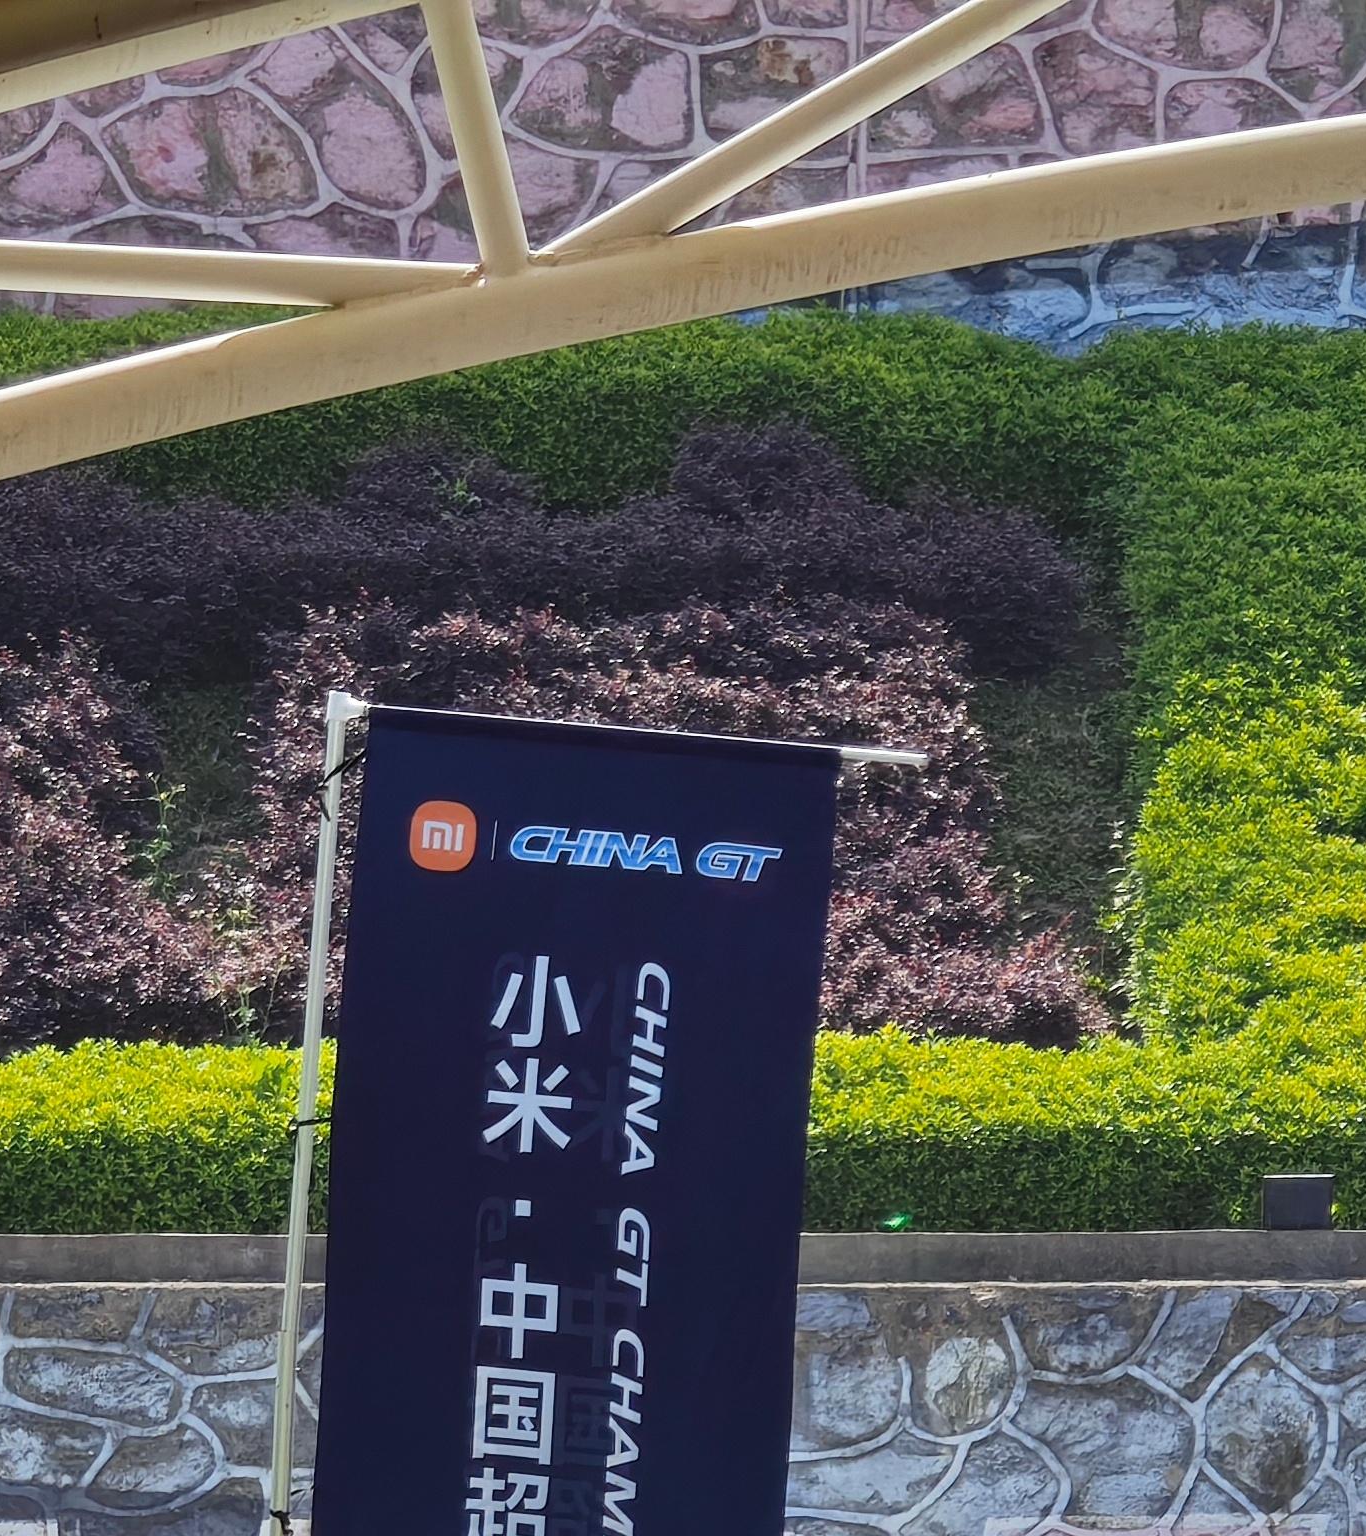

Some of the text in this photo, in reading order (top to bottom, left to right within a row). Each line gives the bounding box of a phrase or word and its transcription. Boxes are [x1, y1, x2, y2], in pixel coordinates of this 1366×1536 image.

[509, 825, 683, 875] CHINA
[695, 841, 784, 882] GT
[620, 961, 671, 1176] CHINA
[615, 1206, 652, 1308] GT
